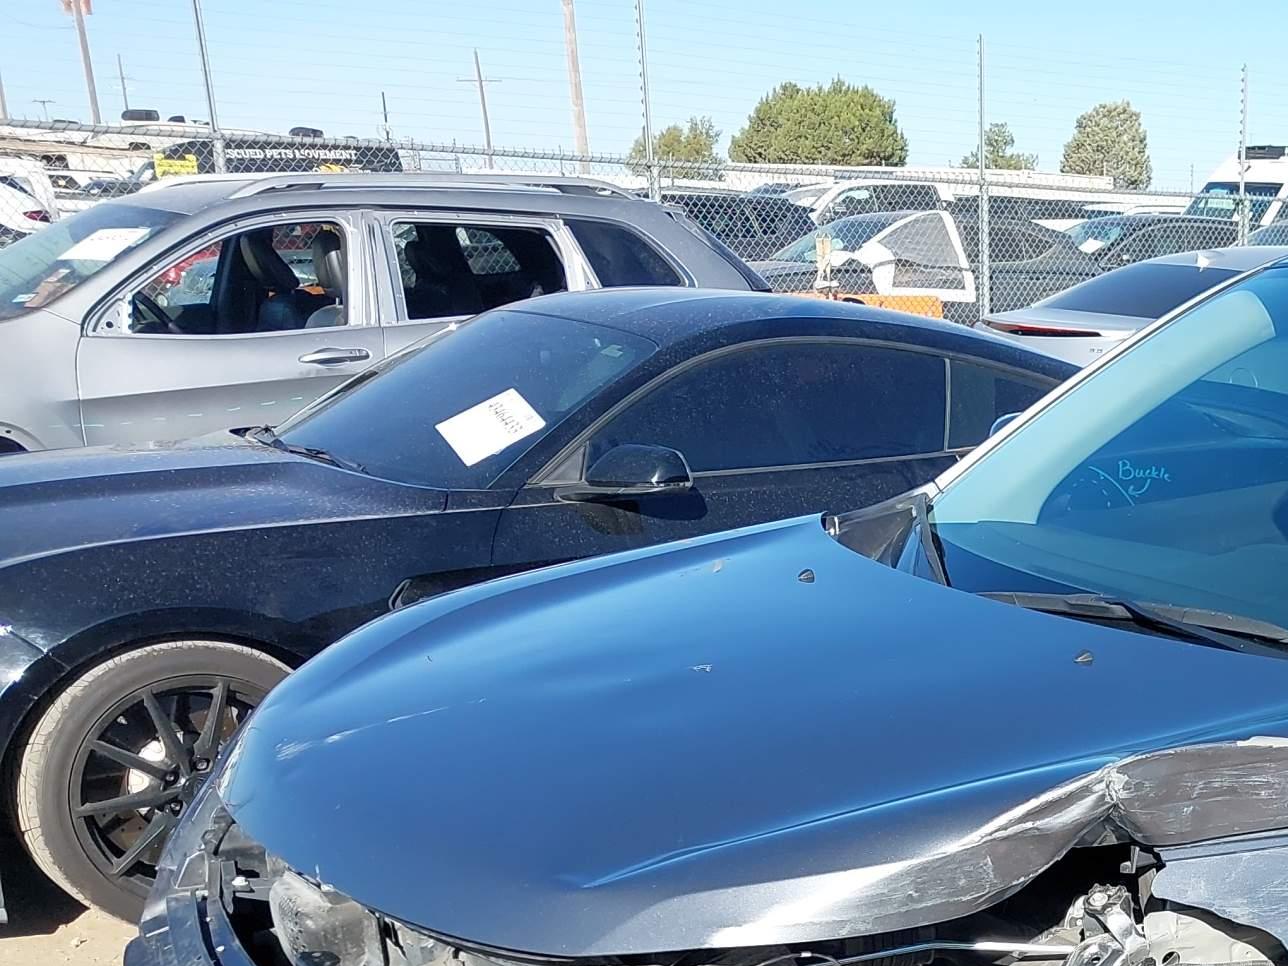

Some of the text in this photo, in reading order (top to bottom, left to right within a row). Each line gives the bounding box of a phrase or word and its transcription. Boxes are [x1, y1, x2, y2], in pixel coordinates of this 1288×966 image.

[222, 148, 265, 159] SCUED
[265, 148, 294, 159] PETS
[1118, 458, 1172, 483] Buckle
